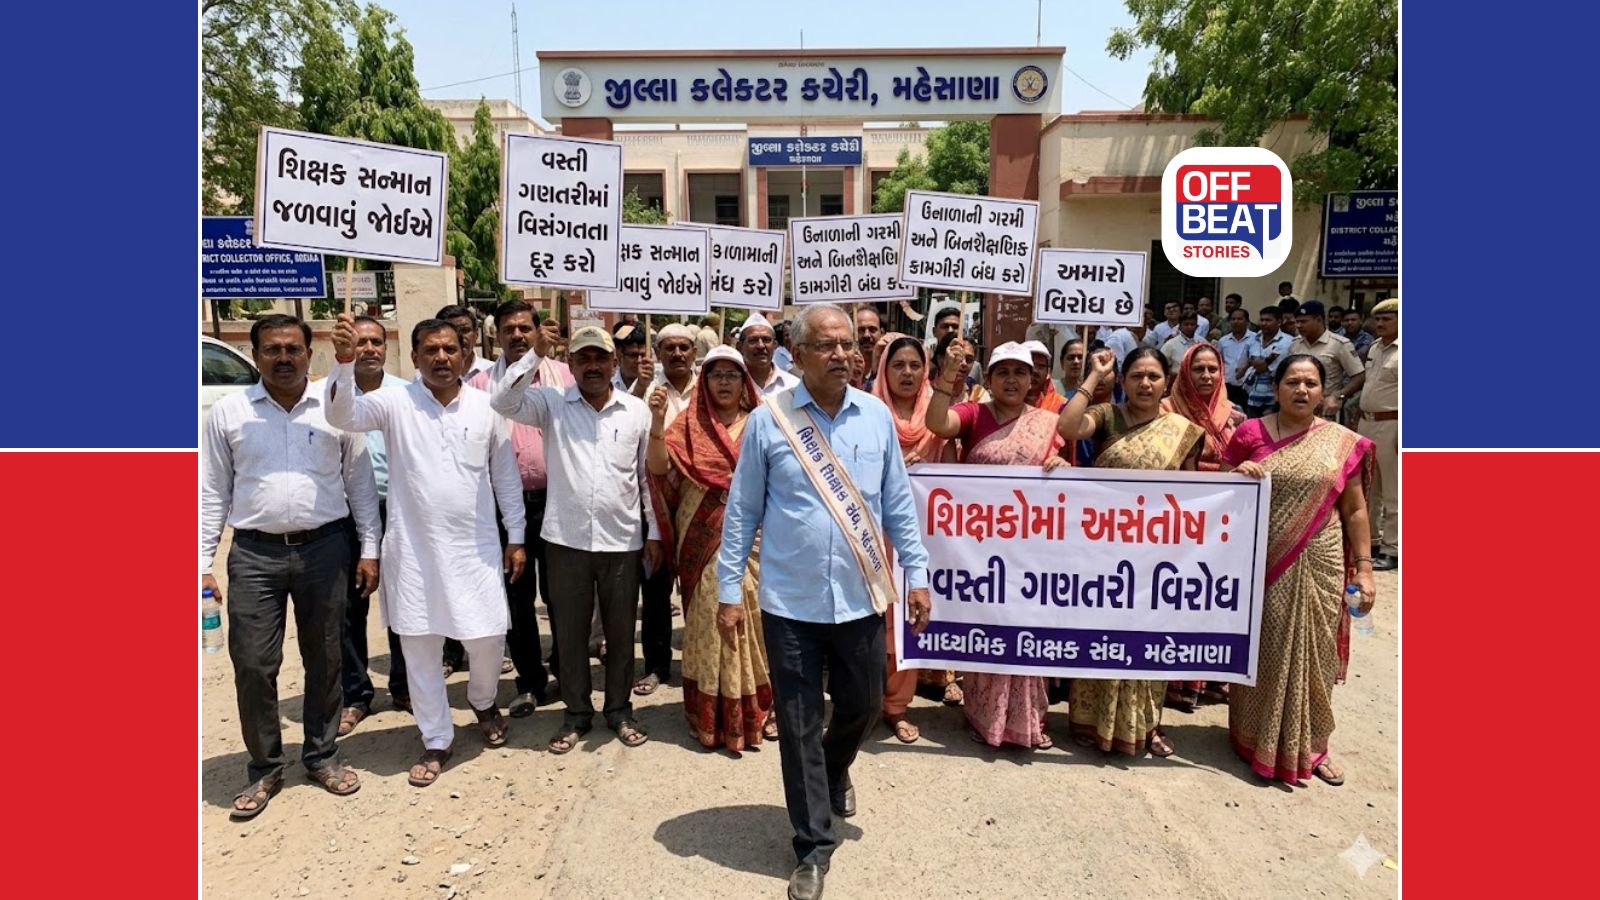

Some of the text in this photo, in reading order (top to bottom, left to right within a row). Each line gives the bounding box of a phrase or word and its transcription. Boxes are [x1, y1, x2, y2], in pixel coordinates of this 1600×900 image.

[604, 66, 999, 109] જીલ્લા કલેકટર કચેરી, મહેસાણા
[278, 147, 432, 197] શિક્ષક સન્માન
[541, 147, 588, 173] વસ્તી
[518, 181, 609, 208] ગણતરીમાં
[273, 199, 433, 240] જળવાવું જોઈએ
[518, 210, 609, 242] વિસંગતતા
[921, 200, 1025, 229] ઉનાળાની ગરમી
[803, 220, 901, 244] ઉનાળાની ગરમી
[911, 227, 1029, 258] અને બિનશૈક્ષણિક
[1330, 227, 1367, 235] DISTRICT
[220, 253, 264, 263] COLLECTOR
[264, 253, 294, 264] OFFICE,
[530, 248, 596, 279] દૂર કરો
[650, 245, 700, 263] સન્માન
[797, 250, 823, 269] અને
[657, 271, 702, 296] જોઈએ
[743, 271, 773, 297] કરો
[857, 273, 881, 292] બંધ
[909, 256, 1026, 285] કામગીરી બંધ કરો
[1057, 258, 1126, 284] અમારો
[1044, 289, 1105, 316] વિરોધ
[1115, 291, 1135, 317] છે
[927, 487, 1066, 543] શિક્ષકોમાં
[1082, 494, 1206, 545] અસંતોષ
[1020, 559, 1135, 610] ગણતરી
[1151, 560, 1240, 612] વિરોધ
[917, 627, 1232, 666] માધ્યમિક શિક્ષક સંઘ, મહેસાણા
